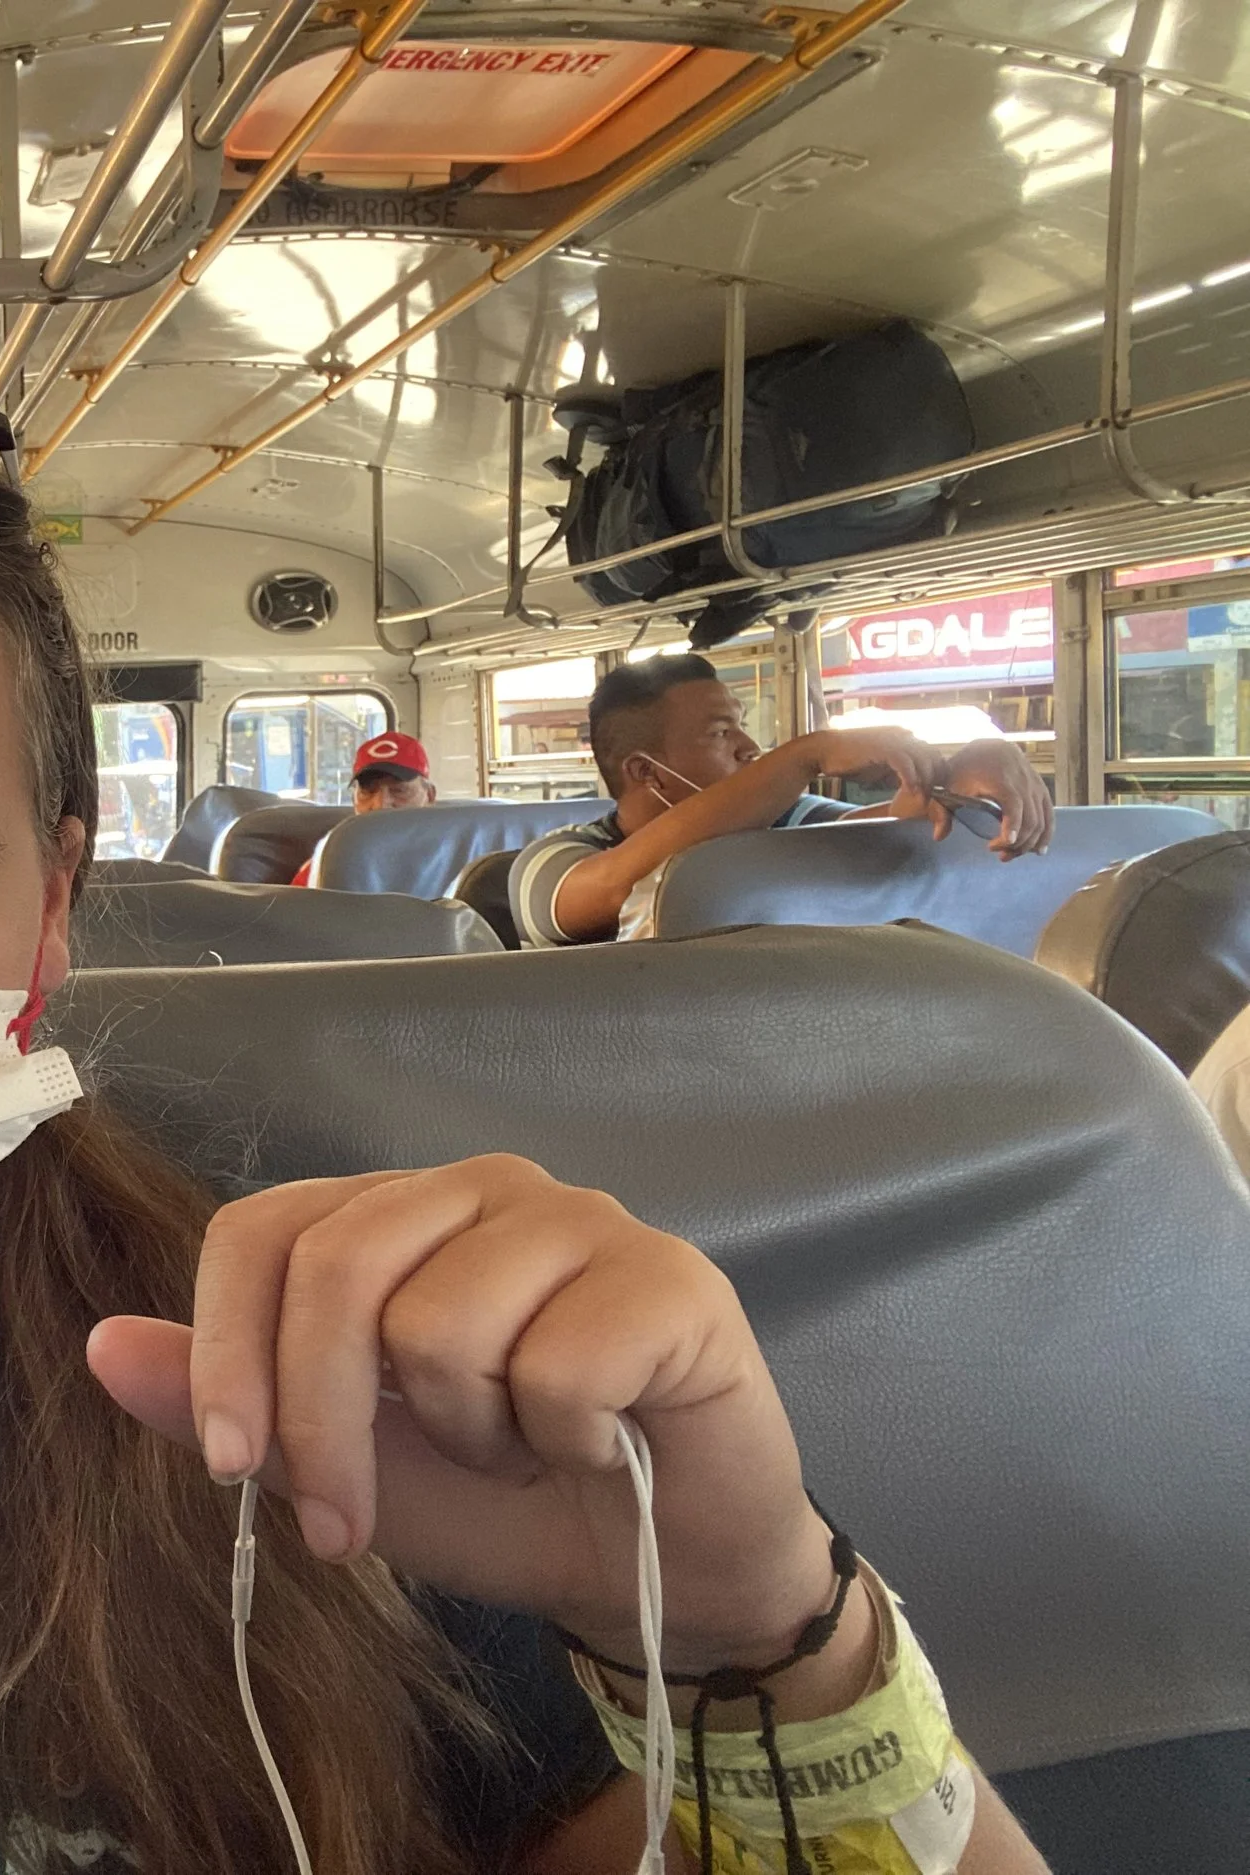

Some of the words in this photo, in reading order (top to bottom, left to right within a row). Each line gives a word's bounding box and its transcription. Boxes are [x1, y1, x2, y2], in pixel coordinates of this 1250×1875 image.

[531, 53, 611, 74] EXIT
[286, 198, 458, 227] AGARRARSE
[88, 632, 138, 651] DOOR
[367, 740, 399, 759] C
